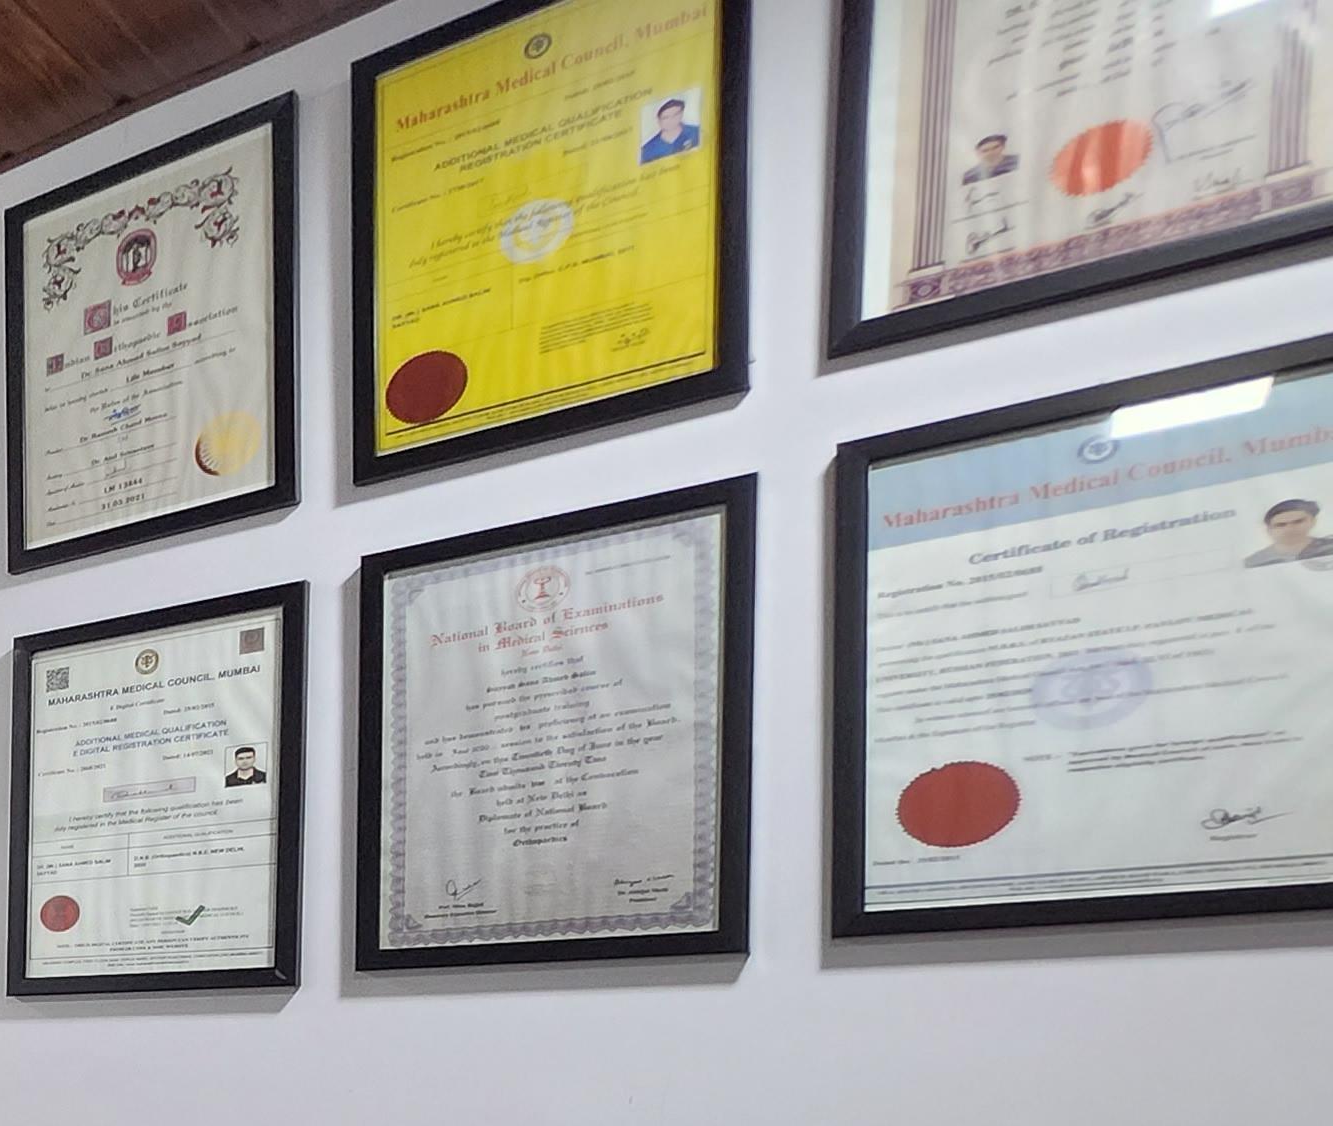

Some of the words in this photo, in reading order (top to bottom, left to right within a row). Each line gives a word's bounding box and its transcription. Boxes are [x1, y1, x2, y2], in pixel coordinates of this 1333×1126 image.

[396, 90, 490, 133] Maharashtra
[496, 66, 557, 97] Medical
[635, 6, 708, 40] Mumbai
[434, 143, 500, 171] ADDITIONAL
[504, 123, 554, 147] MEDICAL
[558, 87, 653, 128] QUALIFICATION
[459, 137, 542, 172] REGISTRATION
[544, 110, 623, 143] CERTIFICATE
[132, 284, 188, 309] Certificate
[116, 352, 144, 368] Ahmed
[143, 362, 175, 377] Member
[882, 491, 1021, 531] Maharashtra
[1030, 468, 1120, 502] Medical
[968, 536, 1073, 567] Certificate
[1077, 530, 1098, 547] of
[1102, 506, 1238, 542] Registration
[430, 626, 489, 650] National
[494, 616, 538, 636] Board
[543, 611, 557, 625] of
[561, 593, 665, 622] Examinations
[478, 642, 490, 653] in
[495, 632, 547, 651] Medical
[551, 620, 609, 641] Sciences
[48, 687, 119, 706] MAHARASHTRA
[122, 681, 165, 695] MEDICAL
[218, 664, 261, 679] MUMBAI
[75, 734, 122, 748] ADDITIONAL
[124, 728, 160, 741] MEDICAL
[162, 719, 227, 735] QUALIFICATION
[80, 745, 110, 758] DIGITAL
[112, 736, 172, 752] REGISTRATION
[174, 728, 229, 744] CERTIFICATE
[424, 738, 439, 746] and
[557, 746, 575, 756] Day
[627, 737, 641, 745] the
[643, 735, 664, 746] year
[68, 821, 98, 833] registered
[107, 818, 117, 827] the
[118, 815, 144, 826] Medical
[145, 813, 170, 825] Register
[73, 812, 95, 825] hereby
[95, 810, 114, 822] certify
[115, 808, 127, 818] that
[129, 807, 139, 816] the
[140, 804, 169, 816] following
[170, 800, 210, 814] qualification
[478, 813, 521, 824] Diplomate
[535, 806, 575, 818] National
[578, 802, 607, 813] Board
[519, 825, 532, 834] the
[534, 822, 568, 833] practice
